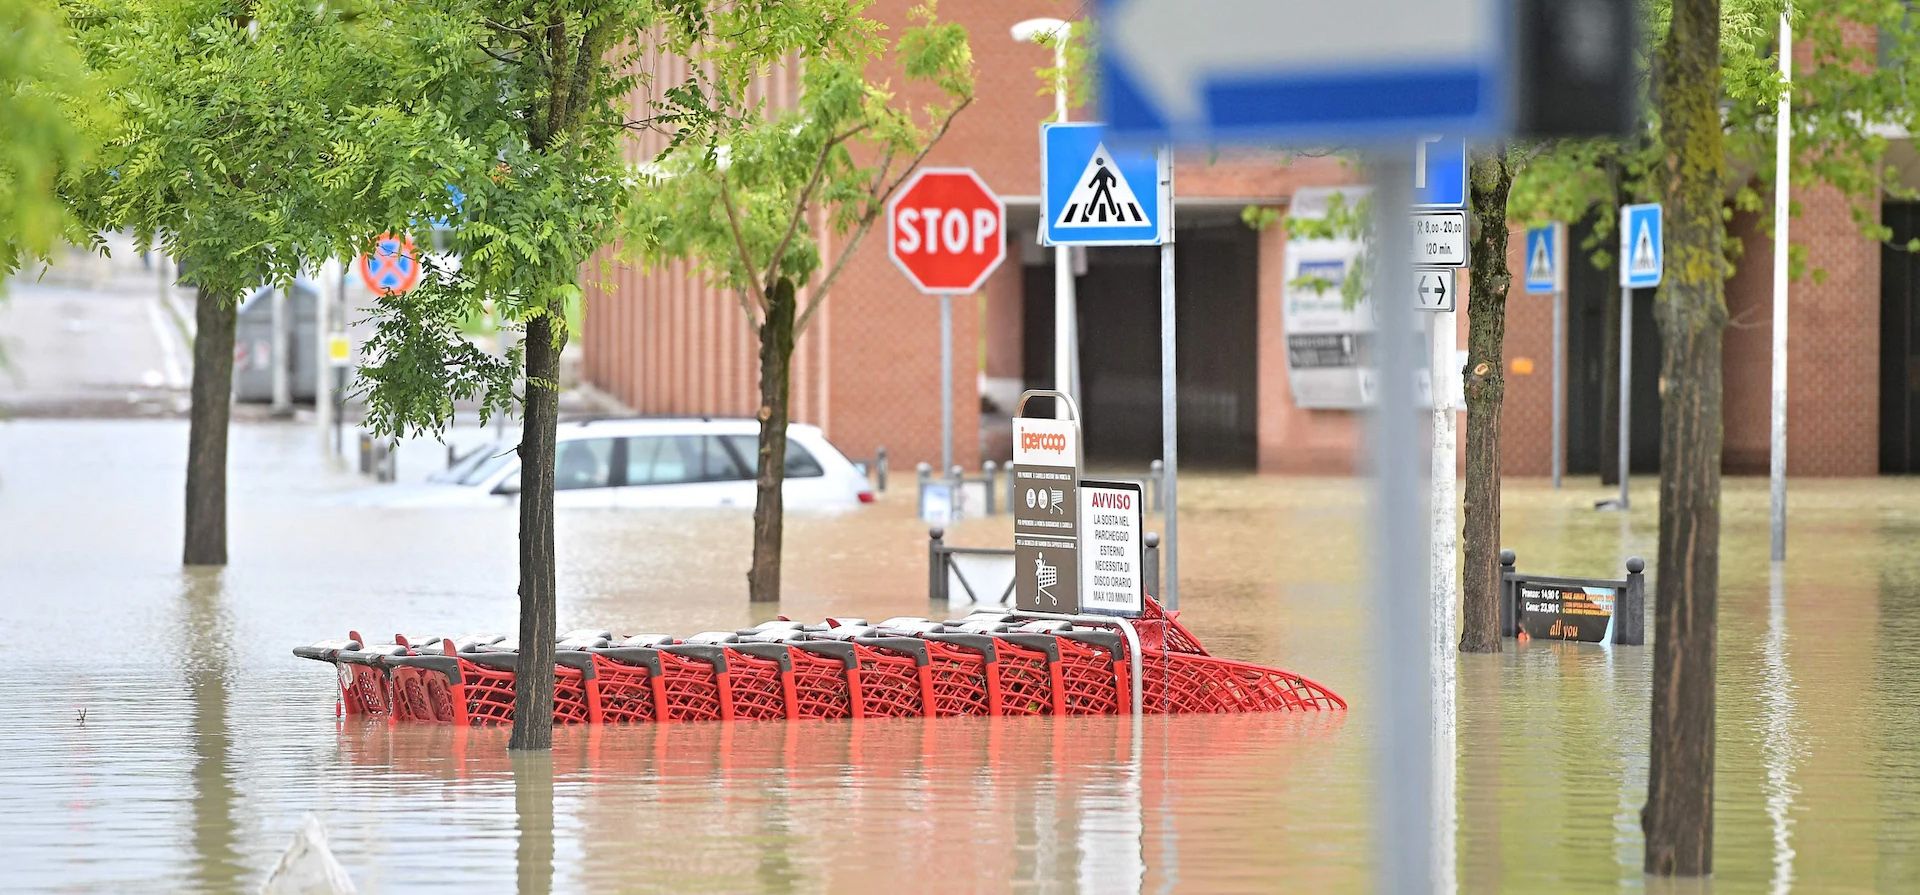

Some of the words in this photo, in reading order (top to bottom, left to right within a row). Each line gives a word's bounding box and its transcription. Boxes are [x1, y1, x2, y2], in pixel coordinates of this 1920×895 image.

[897, 207, 998, 254] STOP
[1426, 243, 1437, 254] 120
[1440, 243, 1452, 254] min.
[1021, 426, 1065, 454] ipercoop
[1092, 492, 1131, 510] AVVISO
[1094, 514, 1101, 525] LA
[1101, 514, 1119, 526] SOSTA
[1119, 515, 1130, 527] NEL
[1095, 529, 1129, 542] PARCHEGGIO
[1100, 545, 1125, 557] ESTERNO
[1095, 560, 1123, 572] NECESSITA
[1124, 562, 1130, 573] DI
[1094, 575, 1110, 587] DISCO
[1111, 576, 1132, 588] ORARIO
[1093, 590, 1105, 602] MAX
[1106, 591, 1115, 602] 120
[1115, 592, 1134, 604] MINUTI
[1541, 588, 1555, 600] 14,90
[1555, 589, 1560, 600] €
[1540, 602, 1555, 613] 23,90
[1555, 604, 1560, 614] €
[1549, 620, 1561, 636] all
[1563, 625, 1578, 640] you
